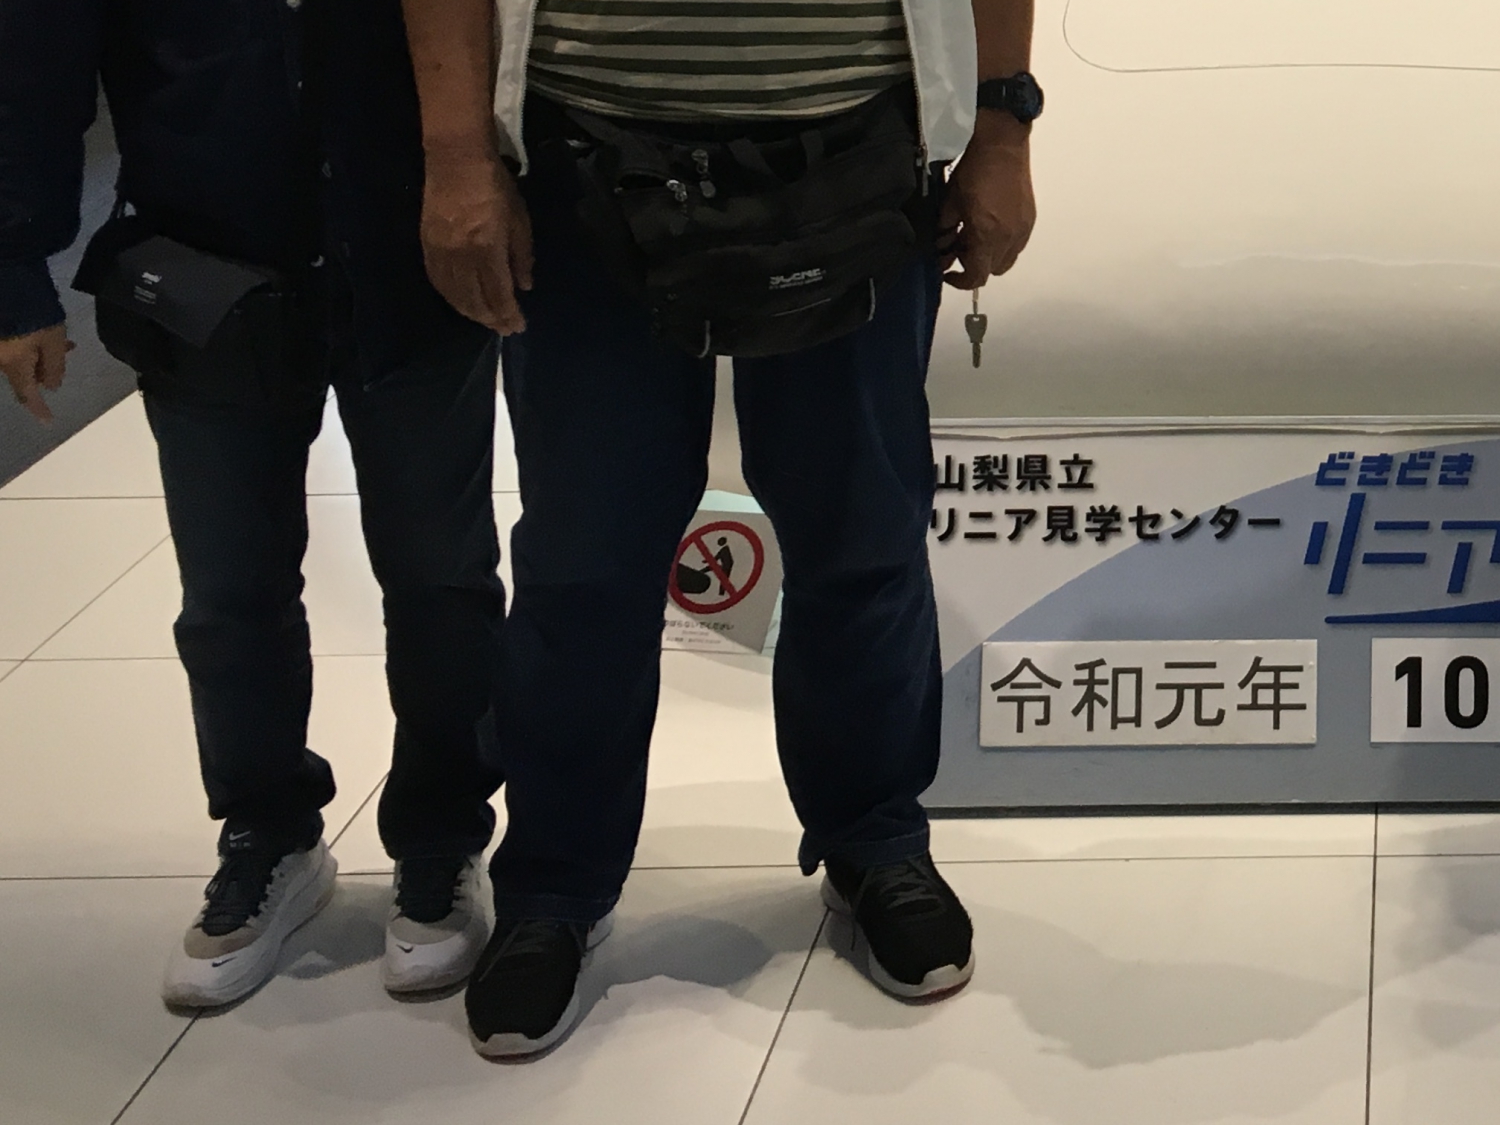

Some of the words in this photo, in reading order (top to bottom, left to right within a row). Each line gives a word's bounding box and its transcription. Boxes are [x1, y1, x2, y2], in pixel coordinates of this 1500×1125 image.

[932, 452, 1095, 493] 山梨県立
[1314, 450, 1475, 487] どきどき
[929, 504, 1282, 543] リニア見学センター
[989, 654, 1308, 734] 令和元年
[1393, 655, 1490, 730] 10
